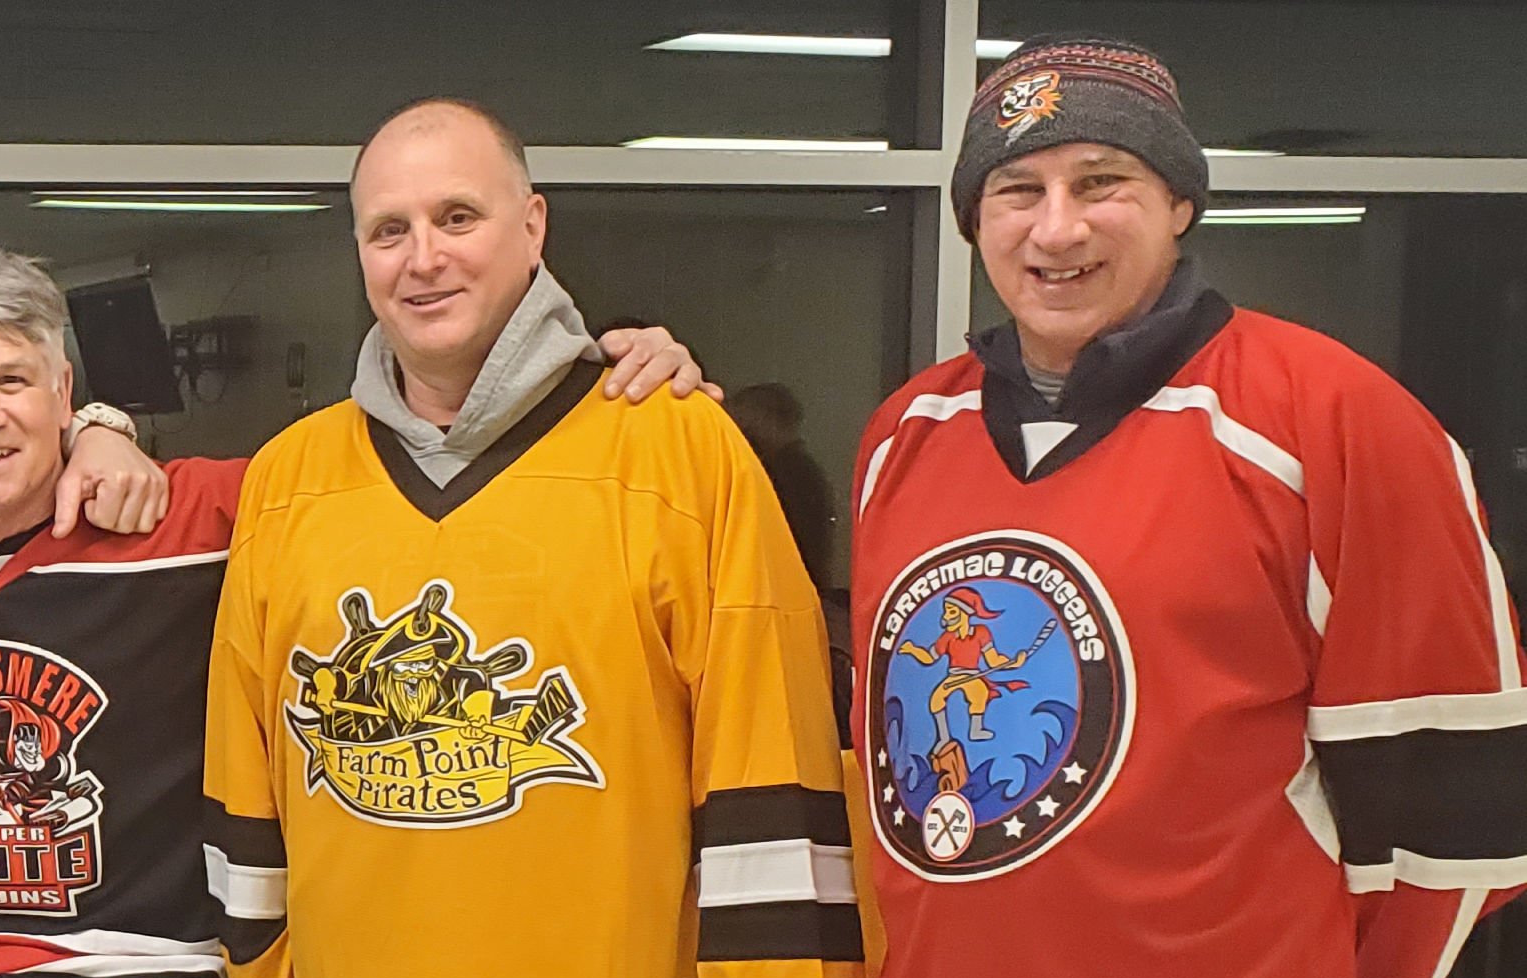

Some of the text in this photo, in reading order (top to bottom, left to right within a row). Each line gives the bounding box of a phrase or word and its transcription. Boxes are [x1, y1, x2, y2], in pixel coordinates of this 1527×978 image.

[336, 735, 508, 779] Farm Point
[355, 776, 482, 812] Pirates
